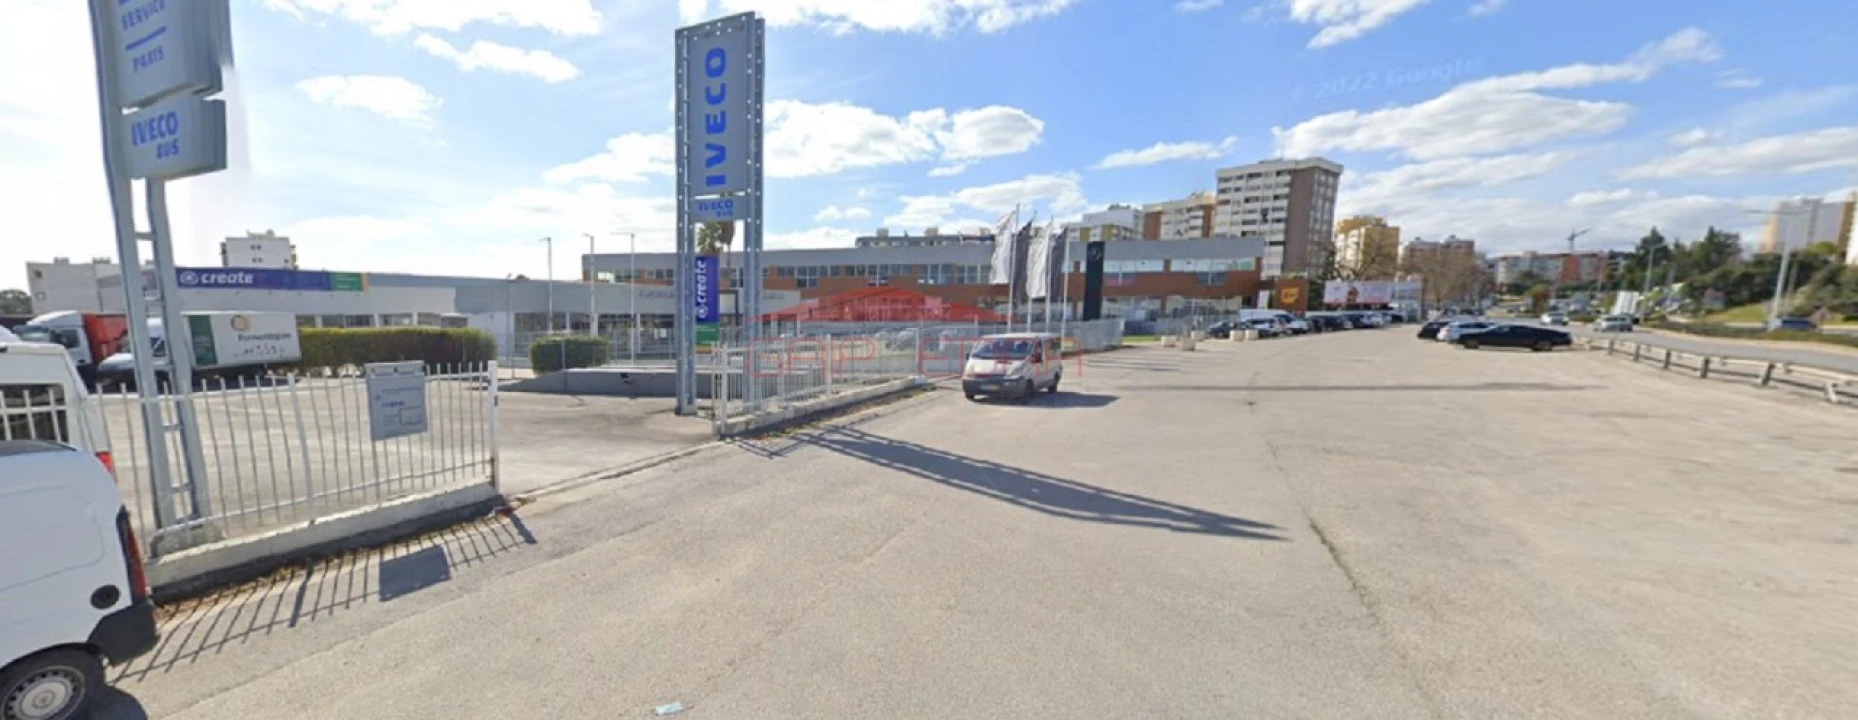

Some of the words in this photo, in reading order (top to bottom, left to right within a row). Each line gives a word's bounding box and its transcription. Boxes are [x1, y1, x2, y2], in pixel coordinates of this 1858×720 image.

[133, 46, 165, 72] PARTS
[131, 111, 180, 146] IVECO
[705, 48, 727, 186] IVECO
[156, 138, 180, 159] BUS
[699, 199, 733, 211] IVECO
[201, 271, 255, 285] create
[696, 259, 708, 303] create
